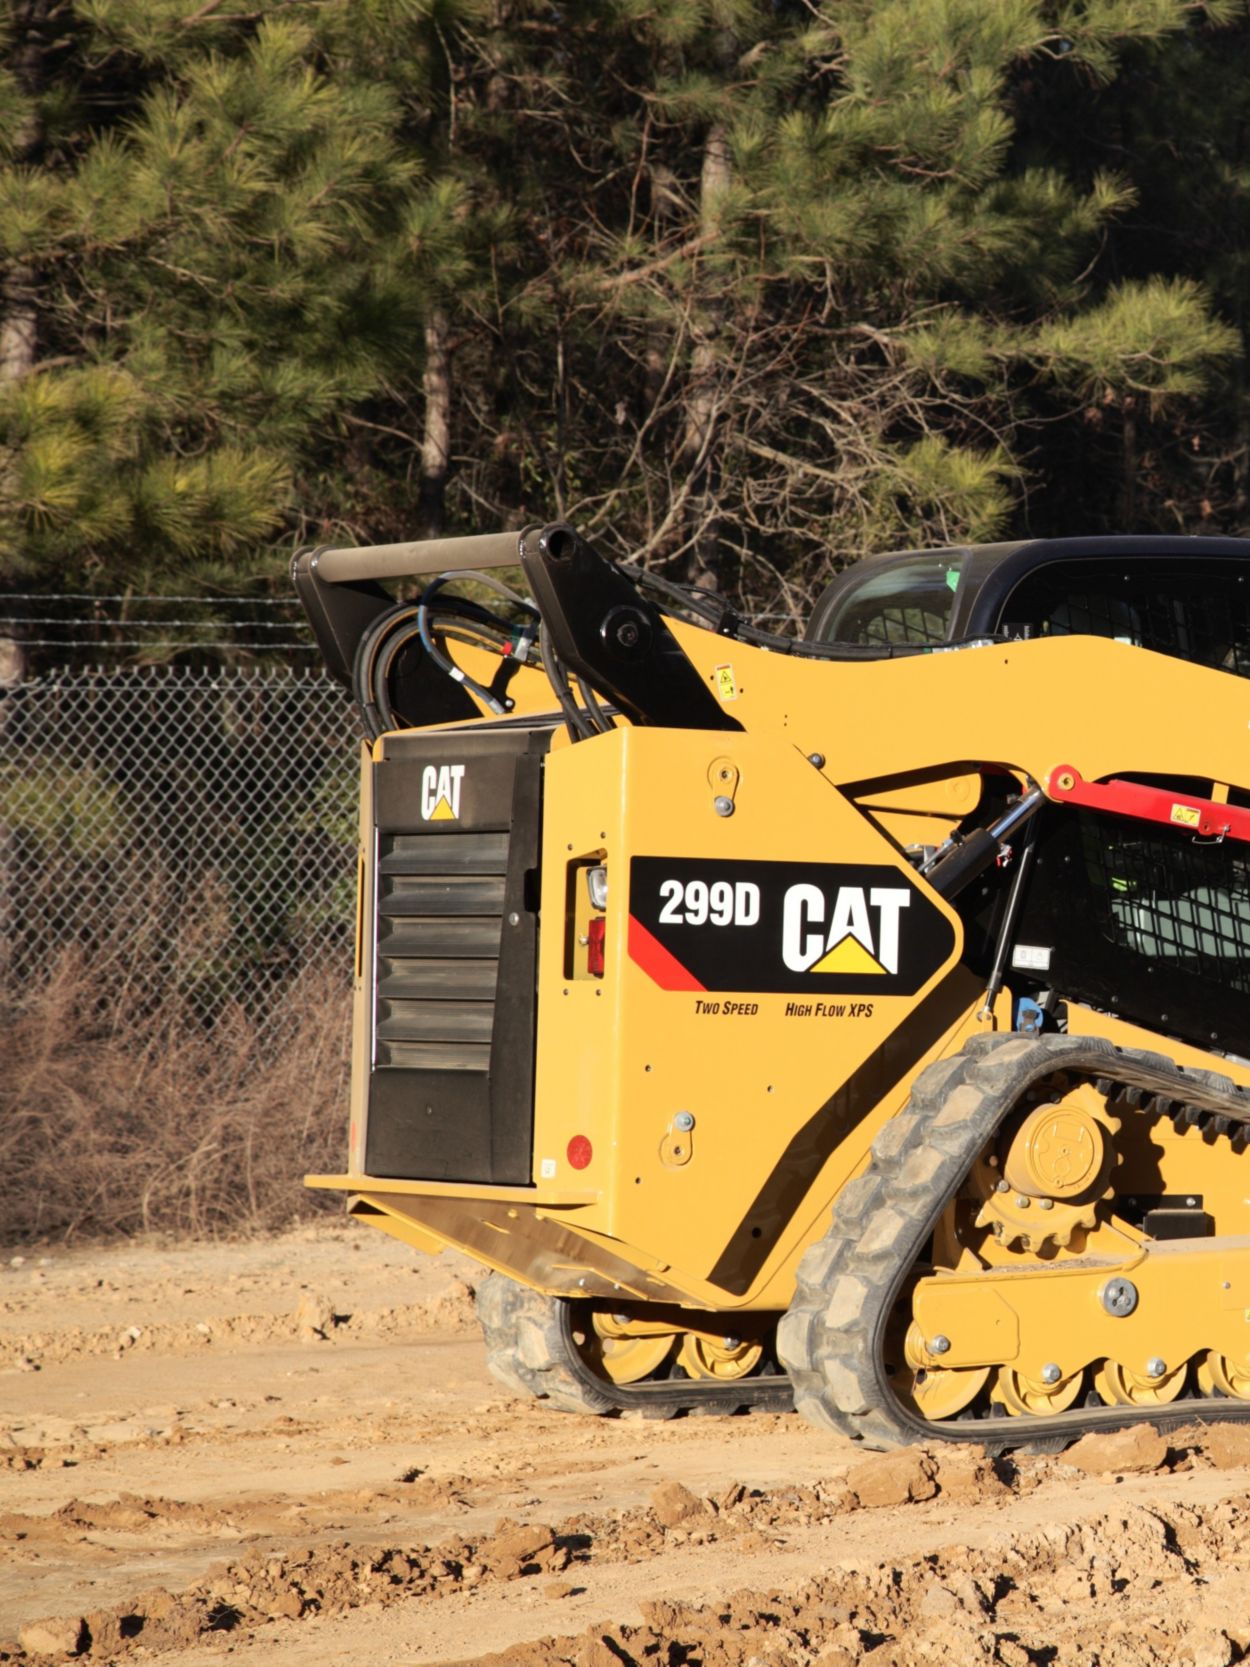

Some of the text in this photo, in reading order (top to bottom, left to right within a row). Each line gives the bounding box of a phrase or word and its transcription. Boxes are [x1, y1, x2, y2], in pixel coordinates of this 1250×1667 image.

[421, 765, 465, 820] CAT
[659, 880, 760, 926] 299D
[782, 883, 910, 974] CAT
[849, 1003, 874, 1018] XPS
